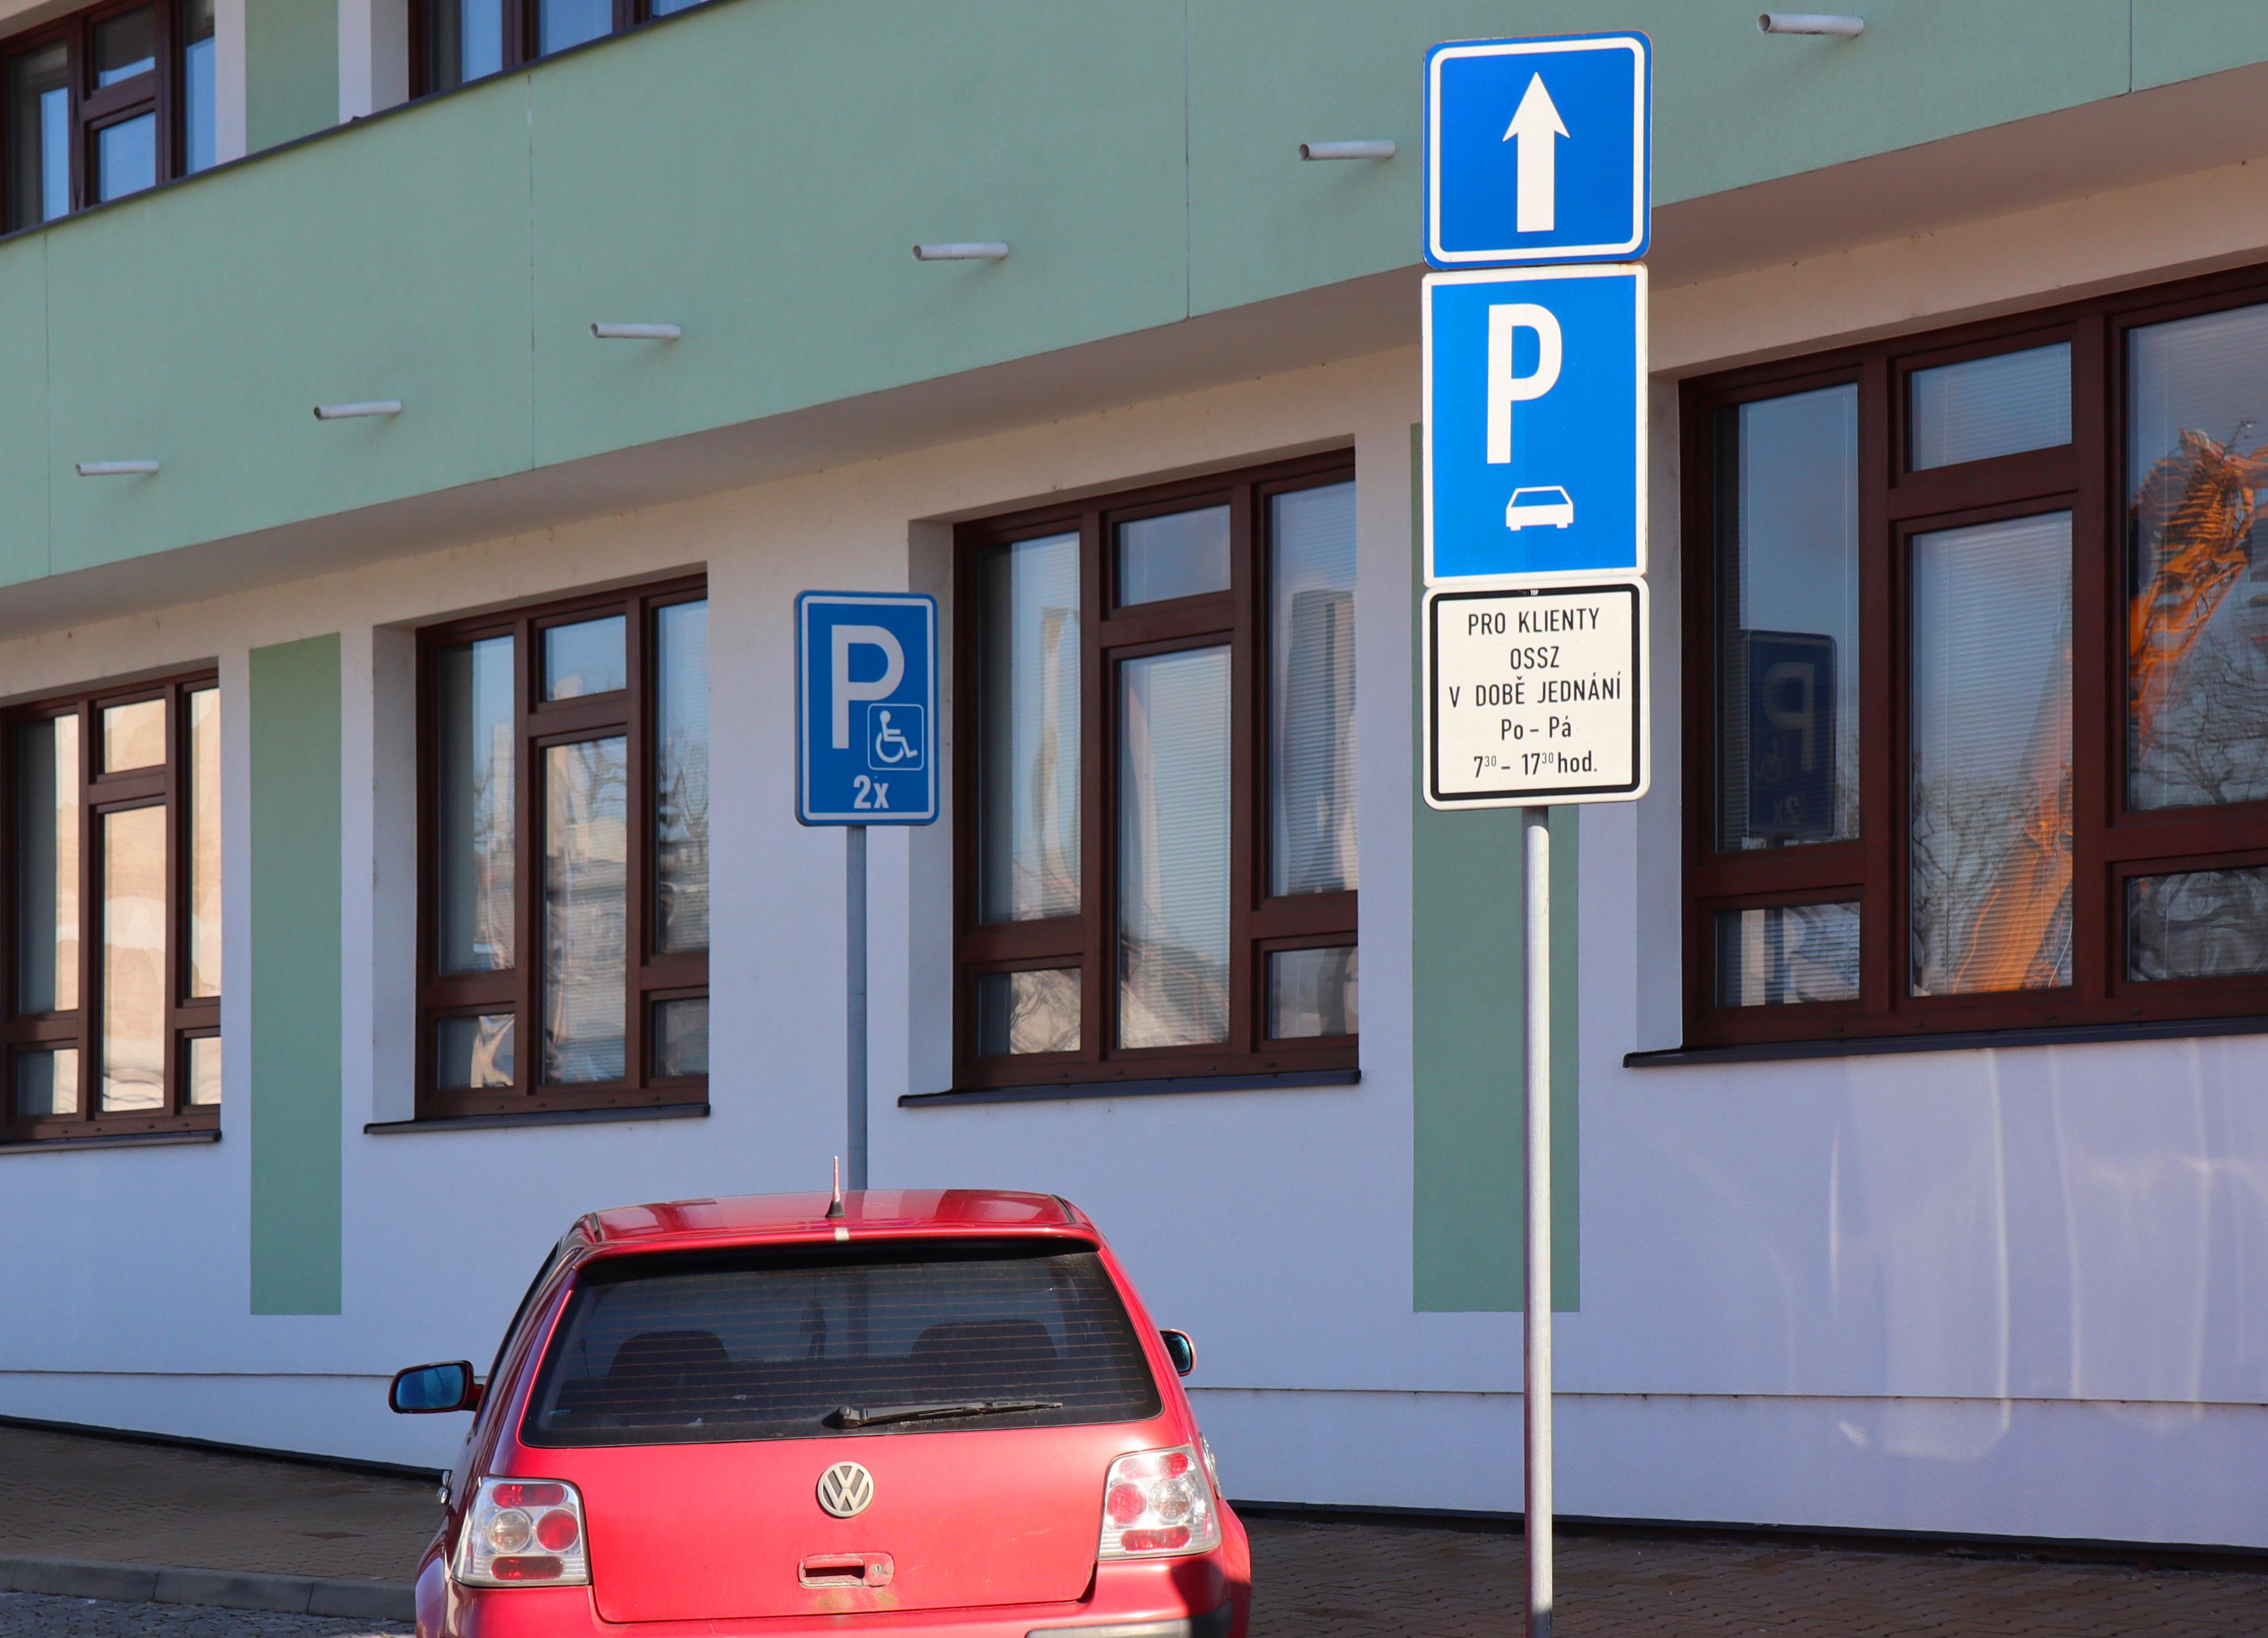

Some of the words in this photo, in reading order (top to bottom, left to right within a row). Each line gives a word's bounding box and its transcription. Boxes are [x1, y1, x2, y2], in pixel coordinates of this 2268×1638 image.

[1487, 303, 1563, 464] P
[1468, 613, 1506, 636] PRO
[1518, 607, 1600, 633] KLIENTY
[1510, 646, 1560, 670] OSSZ
[831, 625, 905, 749] P
[1448, 686, 1460, 708] V
[1475, 676, 1526, 707] DOBĚ
[1537, 671, 1621, 704] JEDNÁNÍ
[1501, 719, 1524, 741] Po
[1549, 715, 1572, 738] Pá
[1557, 750, 1598, 774] hod.
[853, 775, 889, 809] 2x
[818, 1462, 874, 1517] VW
